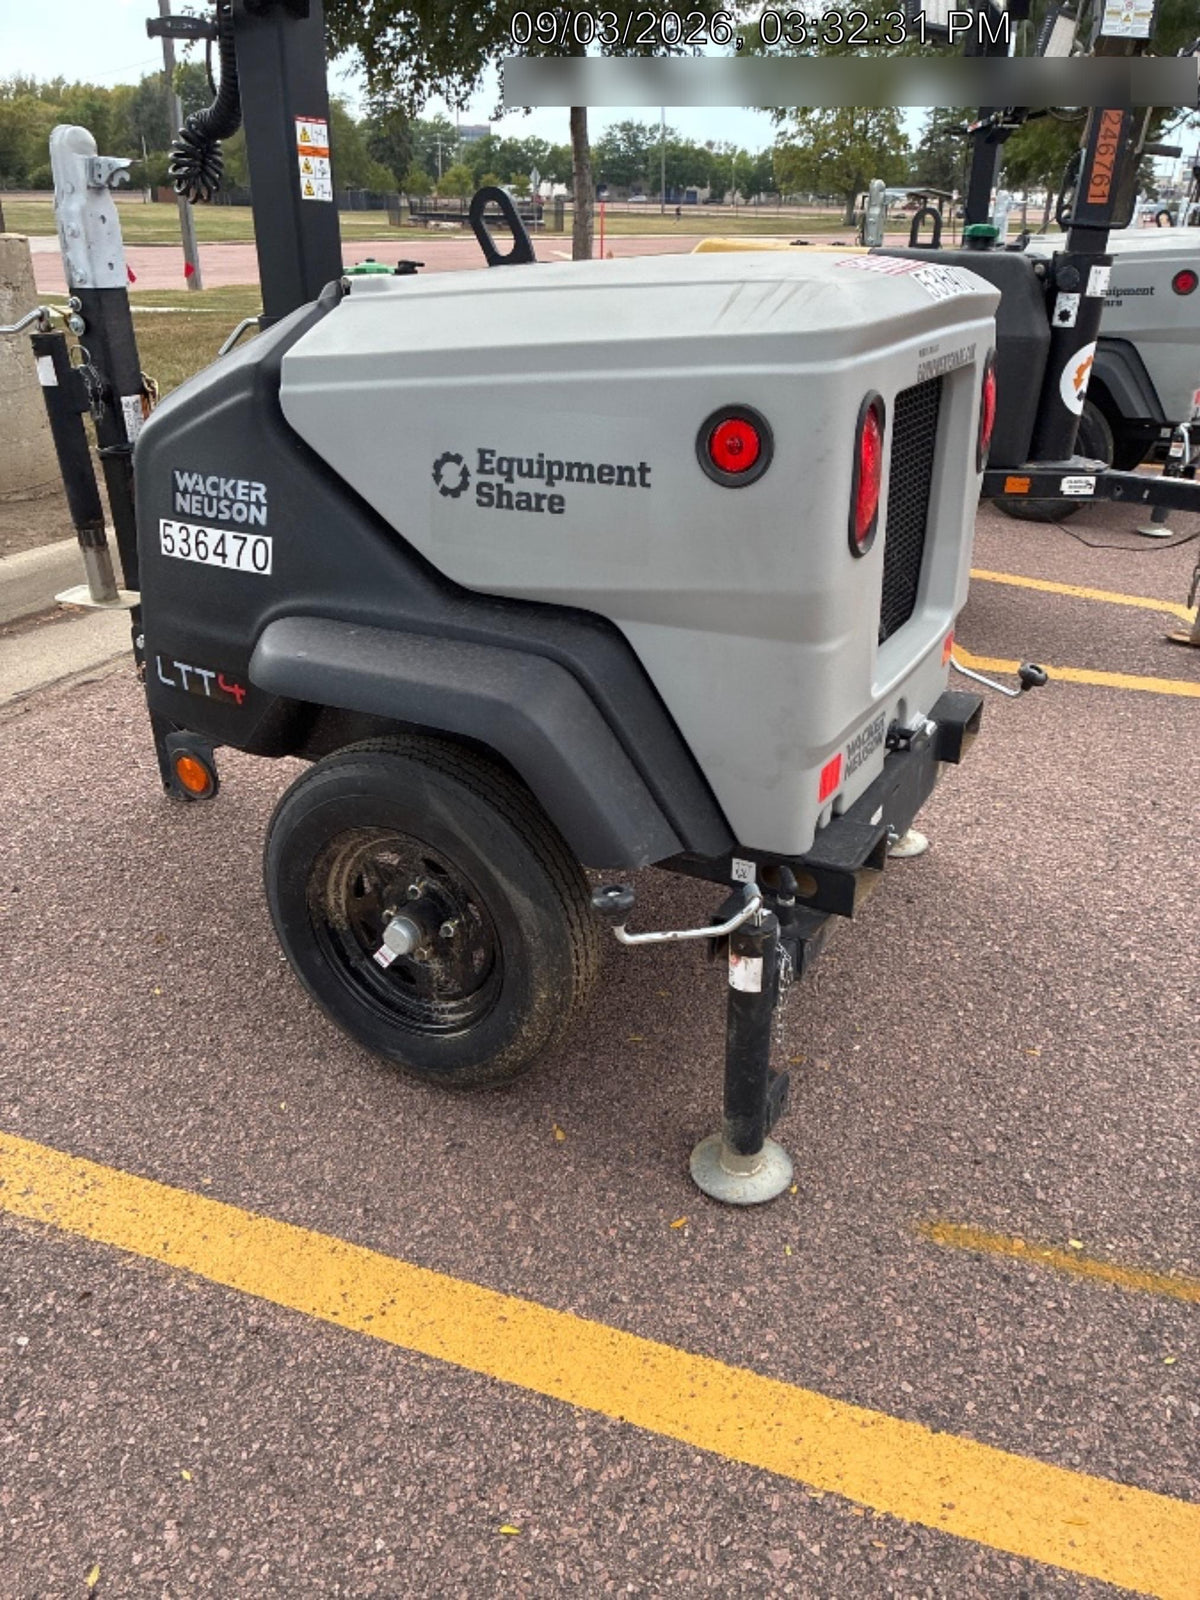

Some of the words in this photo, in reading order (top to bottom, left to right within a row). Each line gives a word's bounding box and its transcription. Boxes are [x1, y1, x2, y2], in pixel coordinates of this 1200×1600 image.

[1090, 112, 1121, 198] 246761
[173, 470, 268, 503] WACKER
[475, 448, 652, 488] Equipment
[174, 492, 268, 526] NEUSON
[475, 481, 566, 515] Share
[162, 522, 269, 572] 536470
[156, 655, 247, 705] LTT4
